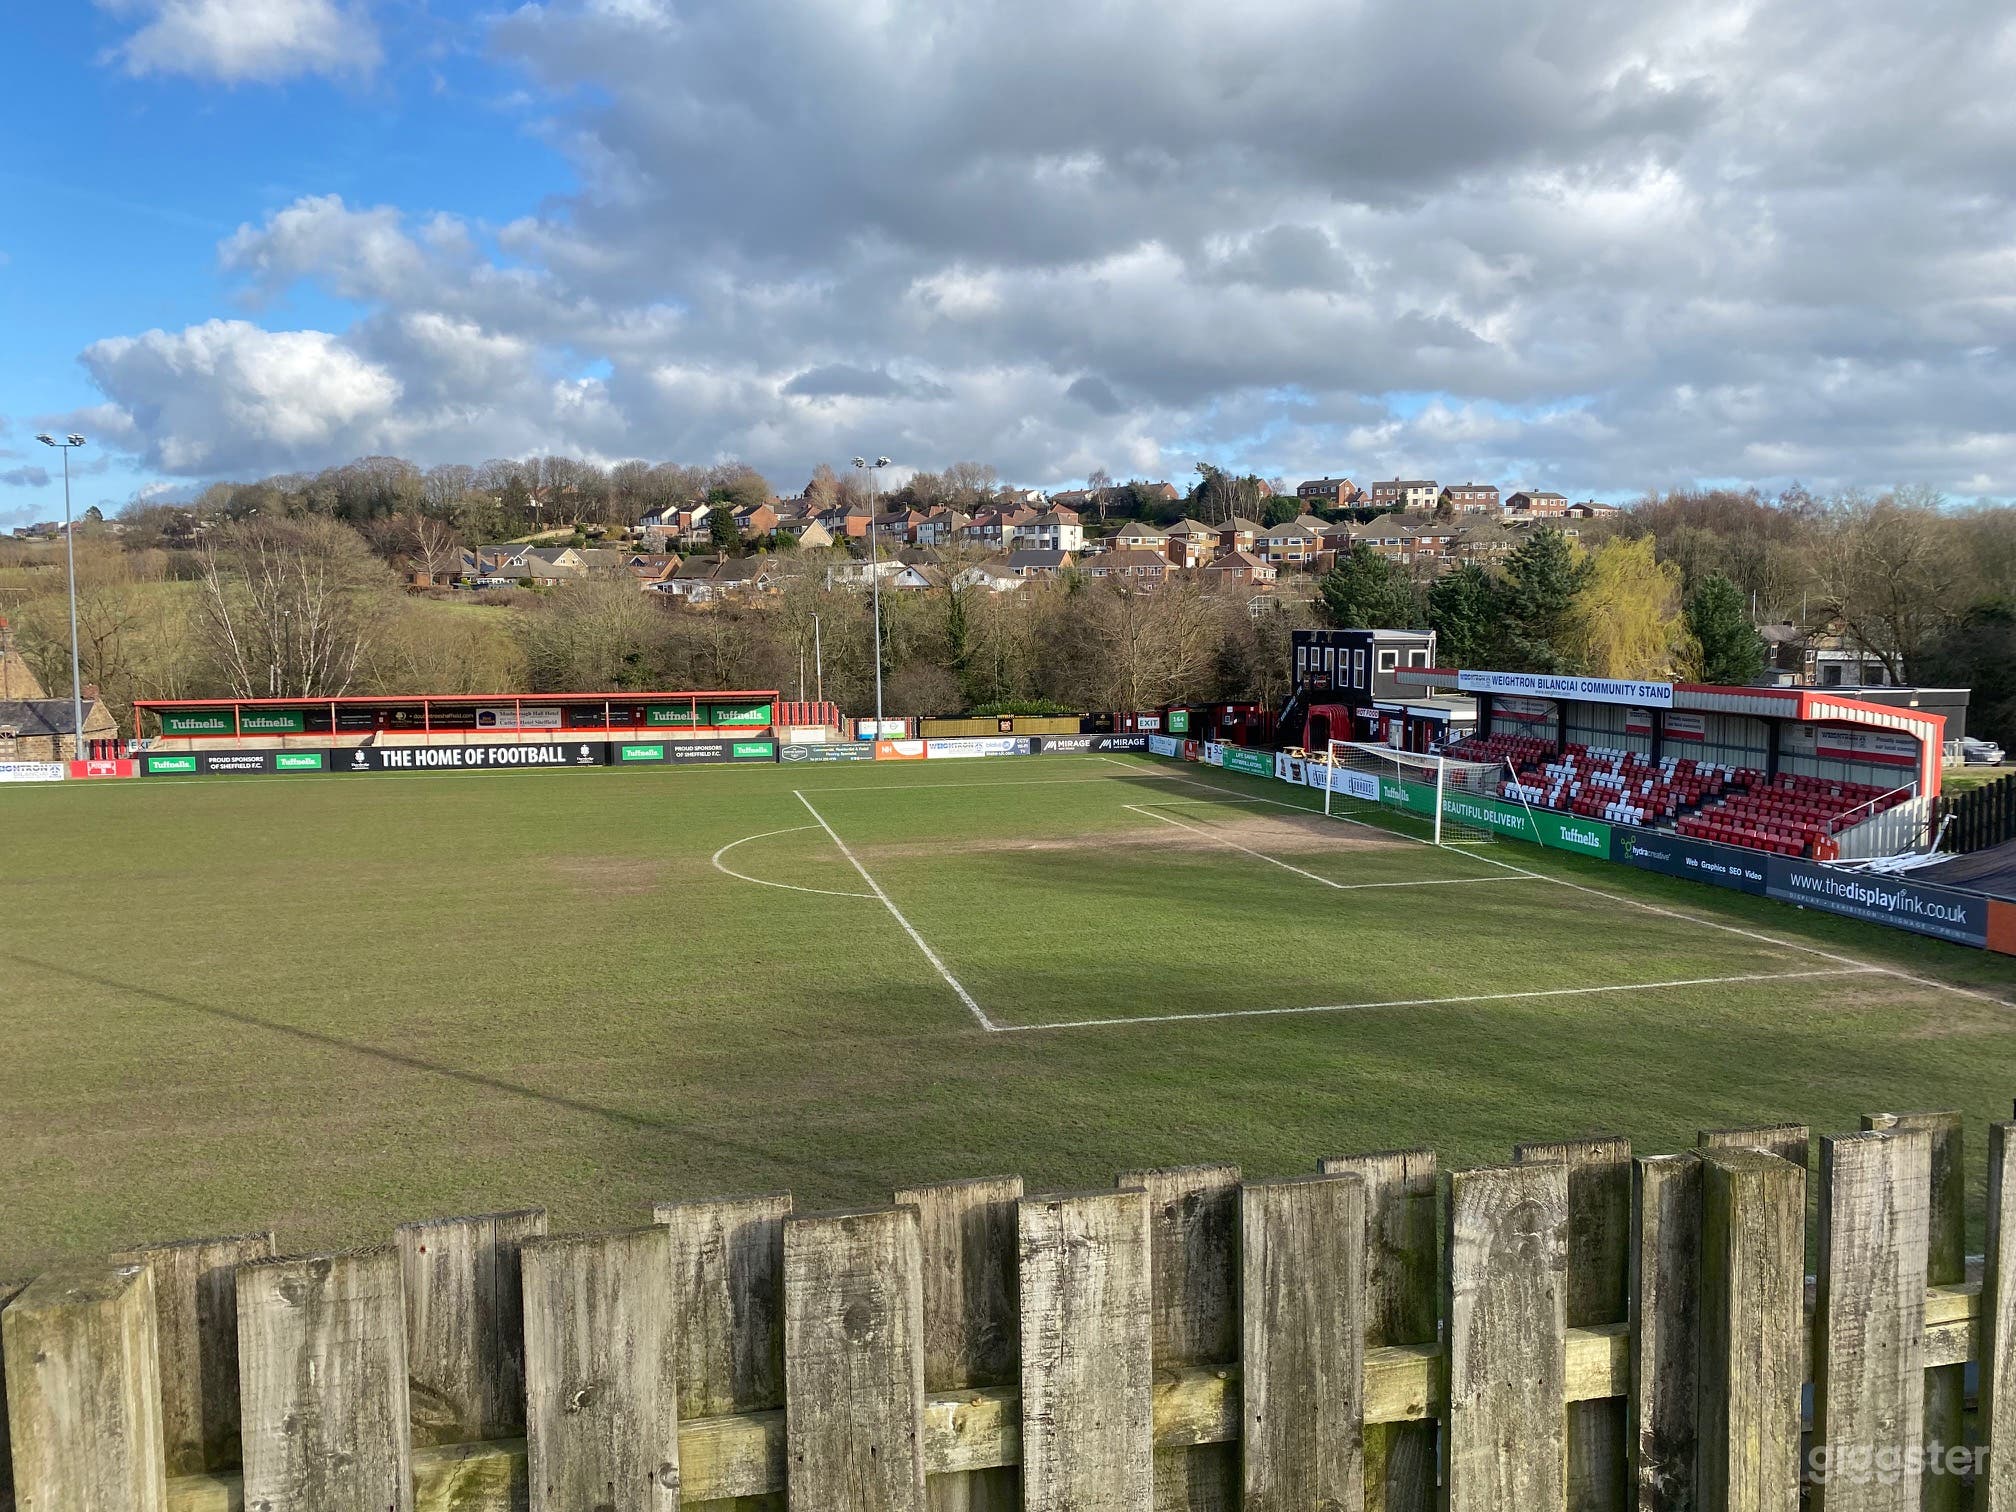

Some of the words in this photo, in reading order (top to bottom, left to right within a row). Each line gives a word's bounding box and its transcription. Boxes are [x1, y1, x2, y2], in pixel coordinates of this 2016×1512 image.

[1492, 677, 1535, 688] WEIGHTRON
[1537, 678, 1578, 692] BILANCIAI
[1581, 681, 1636, 697] COMMUNITY
[1639, 685, 1671, 699] STAND
[1058, 740, 1090, 748] MIRAGE
[1113, 738, 1145, 746] MIRAGE
[381, 750, 412, 767] THE
[415, 749, 462, 766] HOME
[464, 748, 485, 765] OF
[488, 746, 567, 764] FOOTBALL
[1443, 800, 1482, 820] BEAUTIFUL
[1484, 809, 1525, 830] DELIVERY!
[1686, 857, 1699, 867] Web
[1701, 860, 1726, 874] Graphics
[1729, 866, 1742, 876] SEO
[1745, 870, 1762, 881] Video
[1790, 872, 1967, 925] www.thedisplaylink.co.uk
